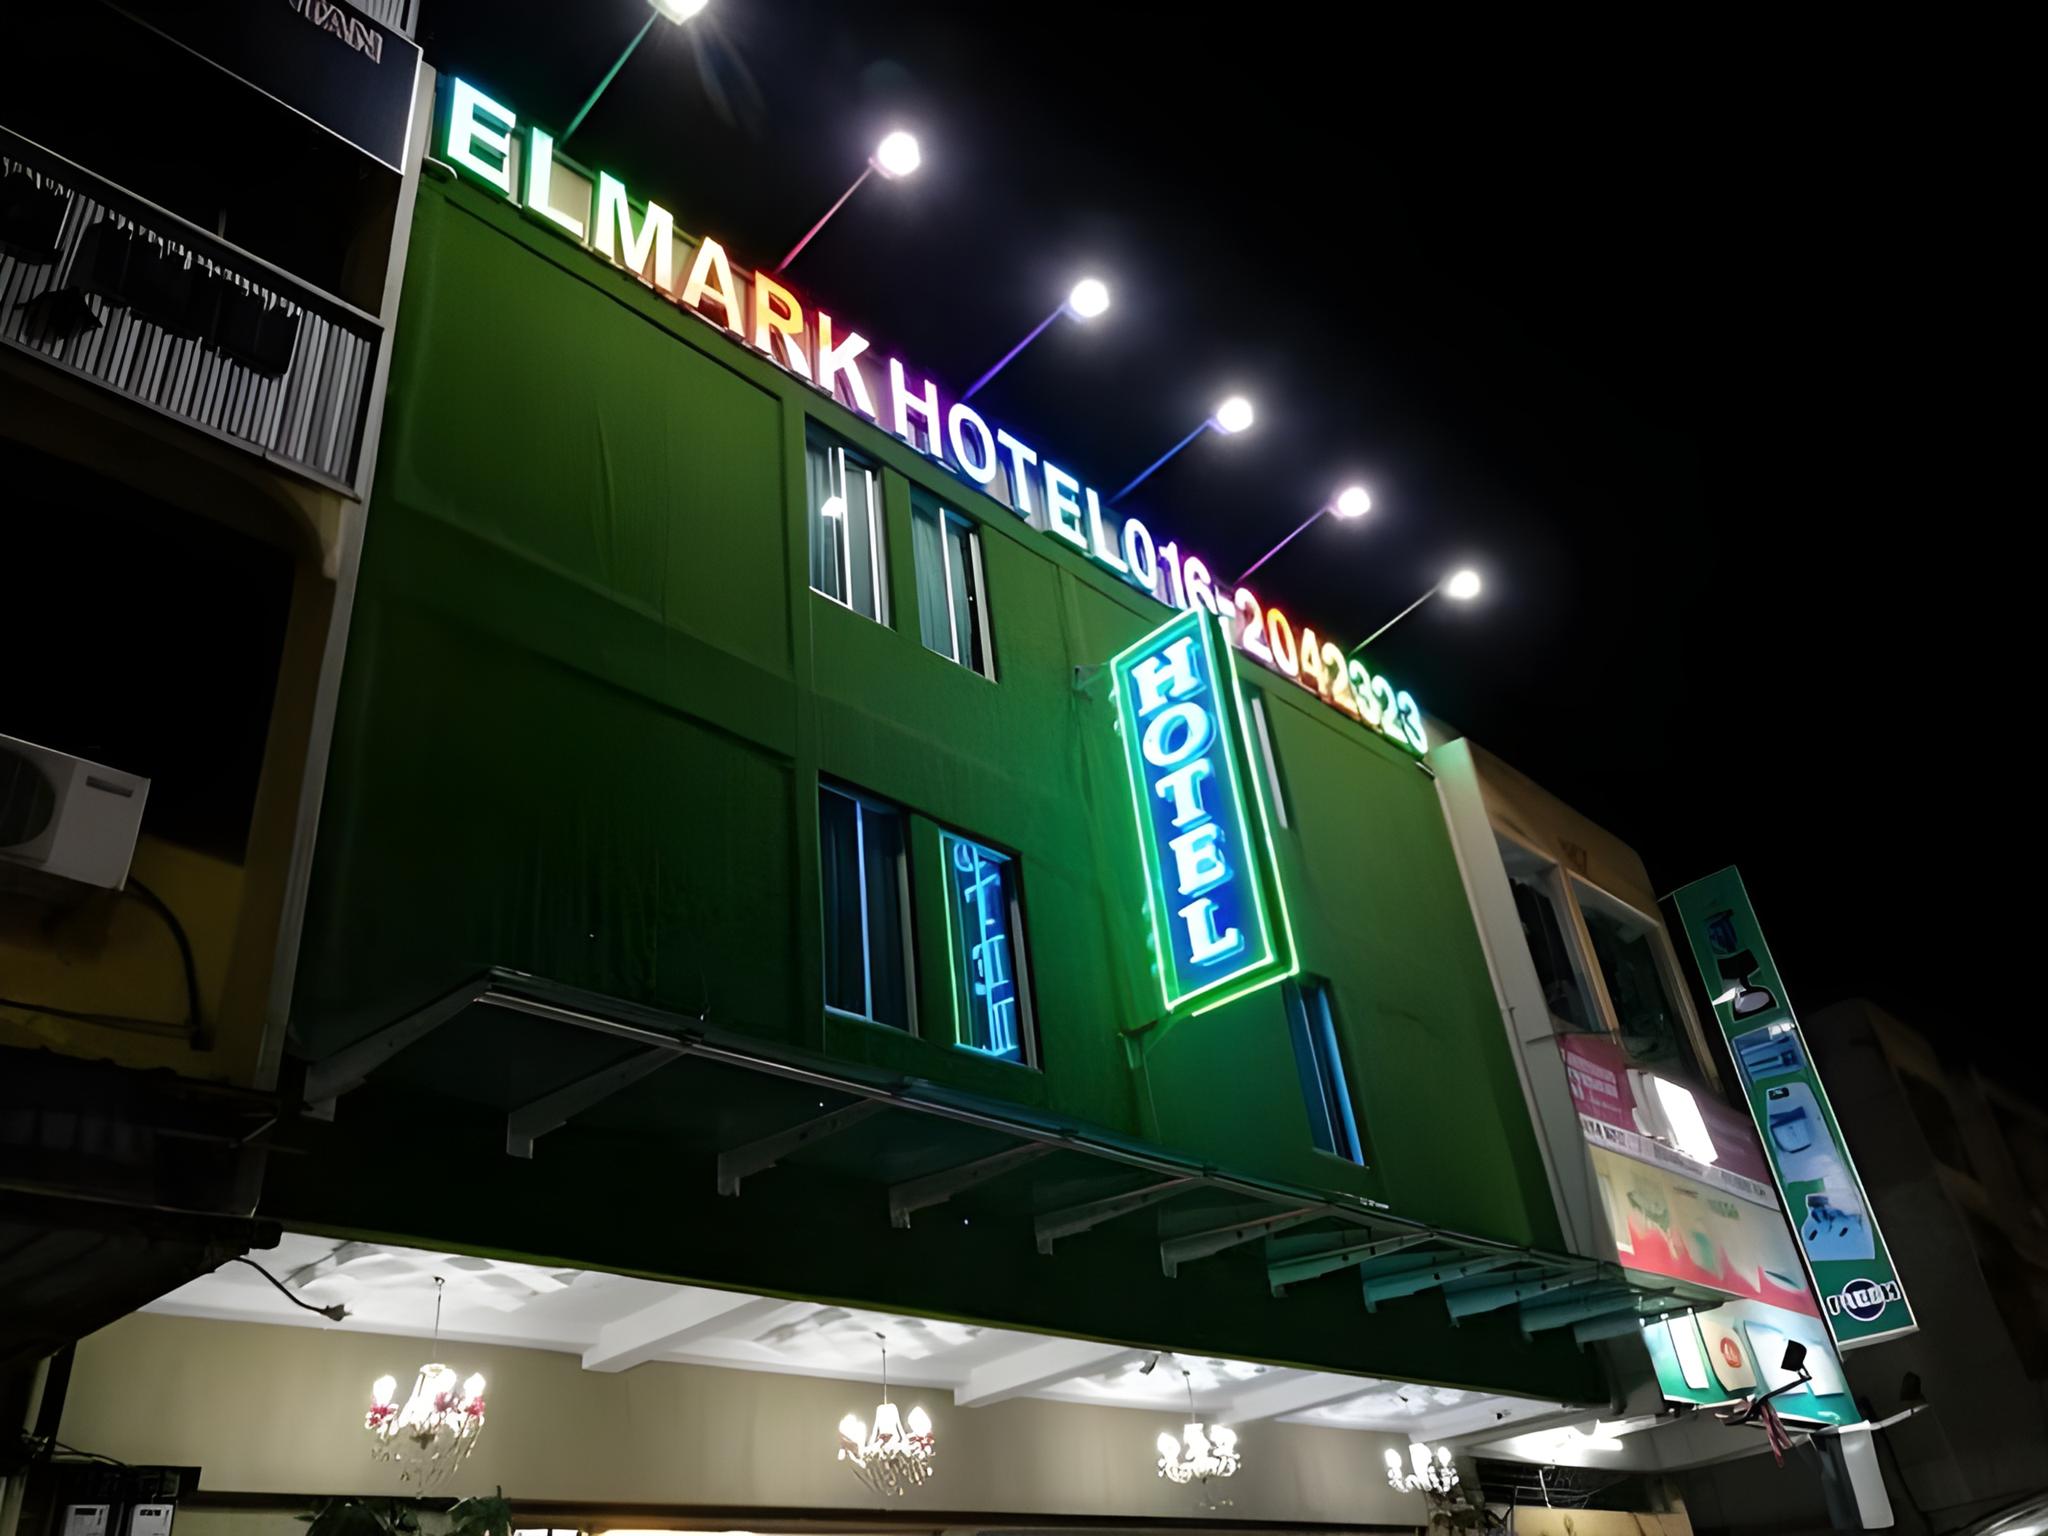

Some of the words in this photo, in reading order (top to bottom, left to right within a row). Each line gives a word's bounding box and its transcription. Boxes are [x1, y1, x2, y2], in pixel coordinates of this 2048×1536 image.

[446, 76, 877, 420] ELMARK
[889, 357, 1129, 574] HOTEL
[1130, 635, 1247, 967] HOTEL
